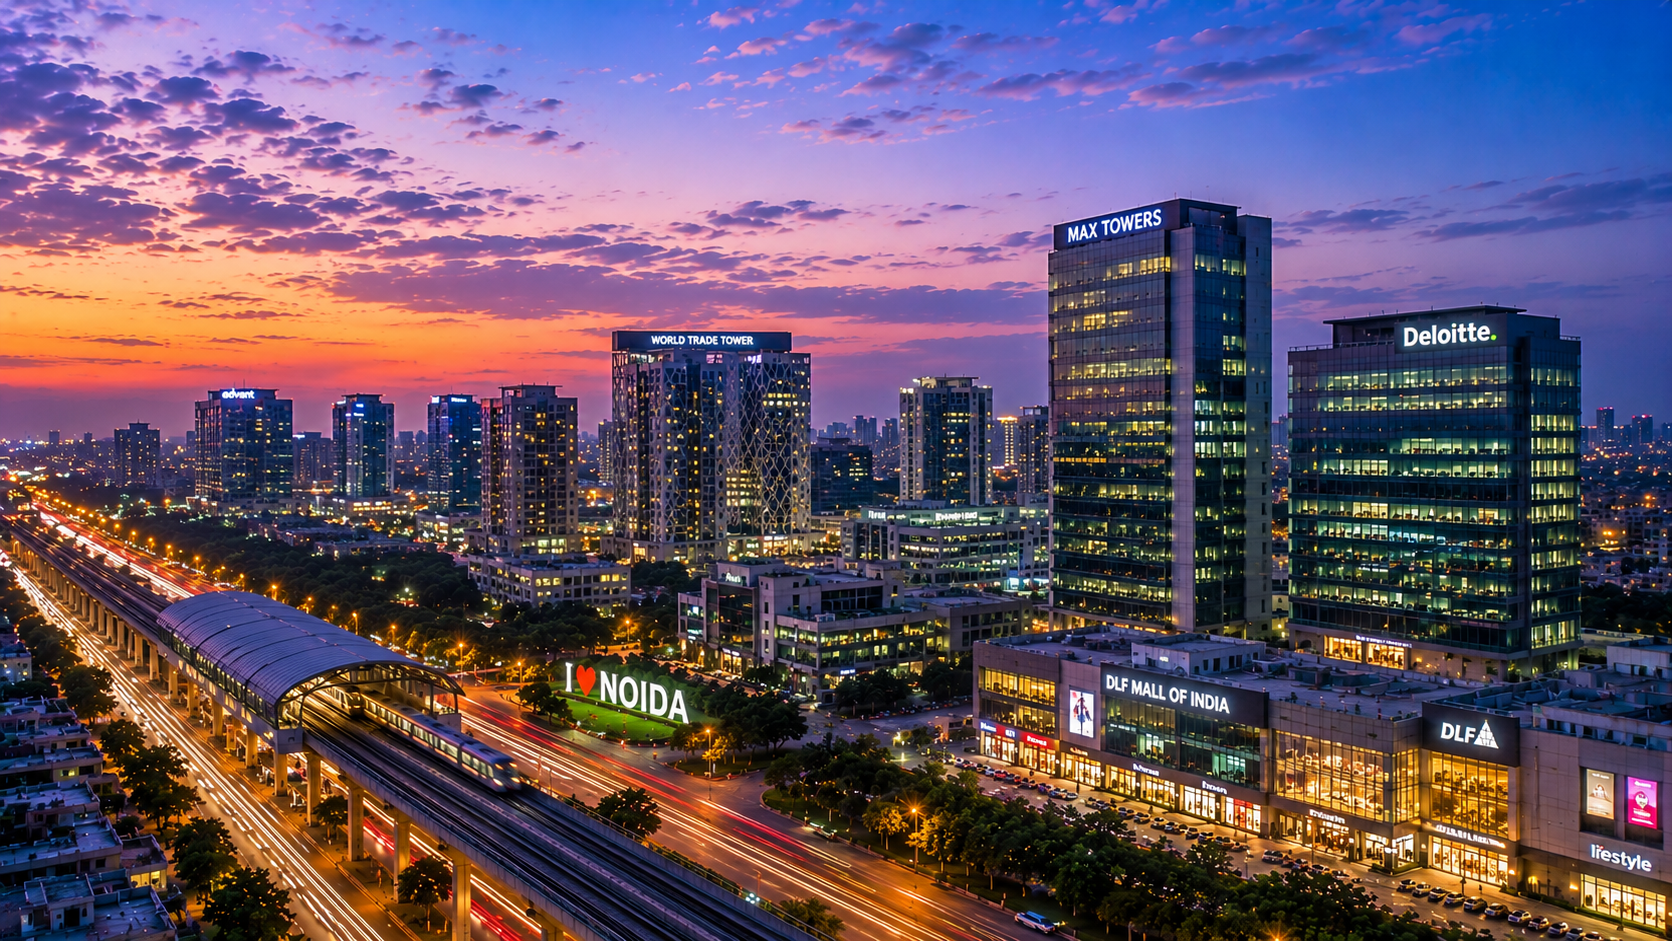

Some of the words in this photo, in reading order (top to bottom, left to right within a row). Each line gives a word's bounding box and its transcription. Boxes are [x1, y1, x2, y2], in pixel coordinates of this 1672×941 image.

[1067, 222, 1098, 243] MAX
[1101, 209, 1162, 236] TOWERS
[651, 335, 686, 346] WORLD
[687, 335, 719, 346] TRADE
[720, 335, 754, 346] TOWER
[565, 662, 573, 693] I
[600, 670, 690, 724] NOIDA
[1106, 674, 1129, 693] DLF
[1131, 679, 1167, 701] MALL
[1168, 686, 1188, 704] OF
[1190, 690, 1231, 714] INDIA
[1440, 721, 1476, 744] DLF
